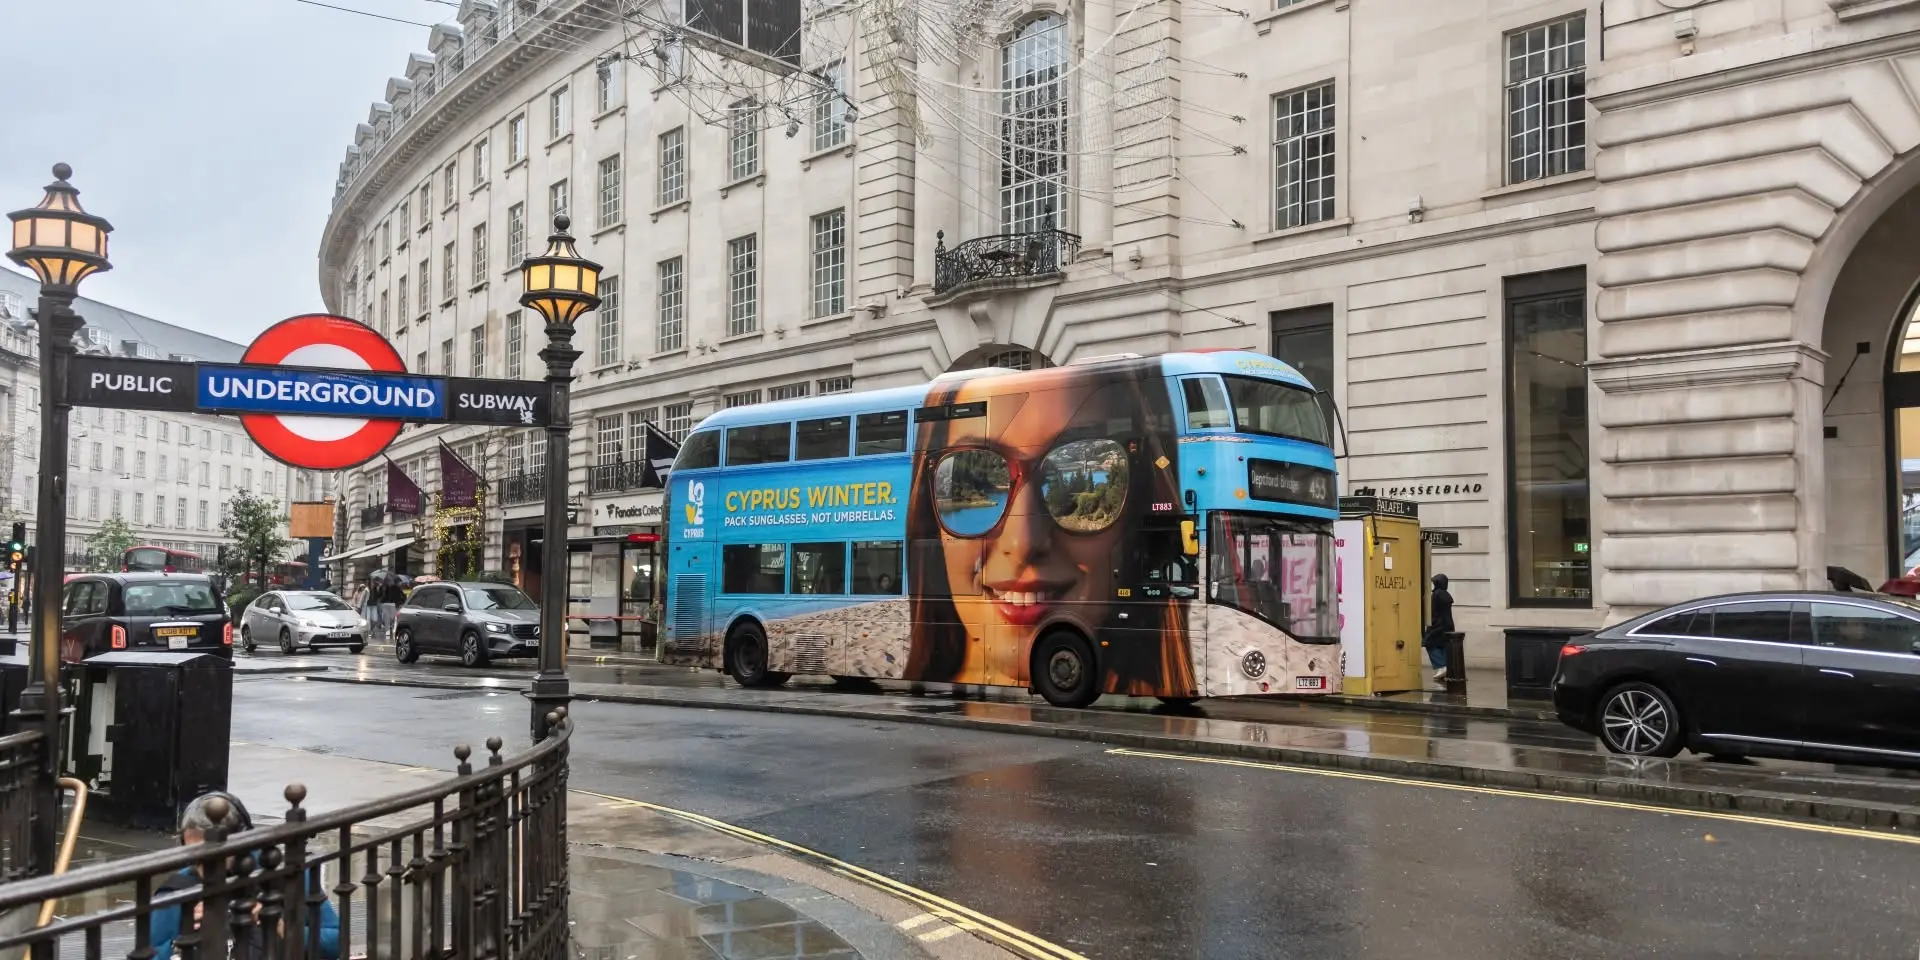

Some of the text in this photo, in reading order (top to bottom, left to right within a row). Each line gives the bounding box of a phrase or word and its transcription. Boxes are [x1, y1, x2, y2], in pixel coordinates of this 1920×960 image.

[91, 372, 172, 393] PUBLIC
[208, 376, 435, 408] UNDERGROUND
[459, 393, 537, 411] SUBWAY
[1251, 470, 1279, 488] Deptford
[1308, 475, 1327, 500] 453
[725, 482, 897, 512] CYPRUS WINTER.
[1388, 483, 1482, 498] HASSELBLAD
[614, 504, 642, 519] Fanatics
[1152, 503, 1172, 511] LT883
[1376, 500, 1405, 514] FALAFEL
[724, 509, 896, 527] PACK SUNGLASSES, NOT UMBRELLAS.
[683, 527, 704, 538] CYPRUS
[1375, 575, 1406, 589] FALAFEL
